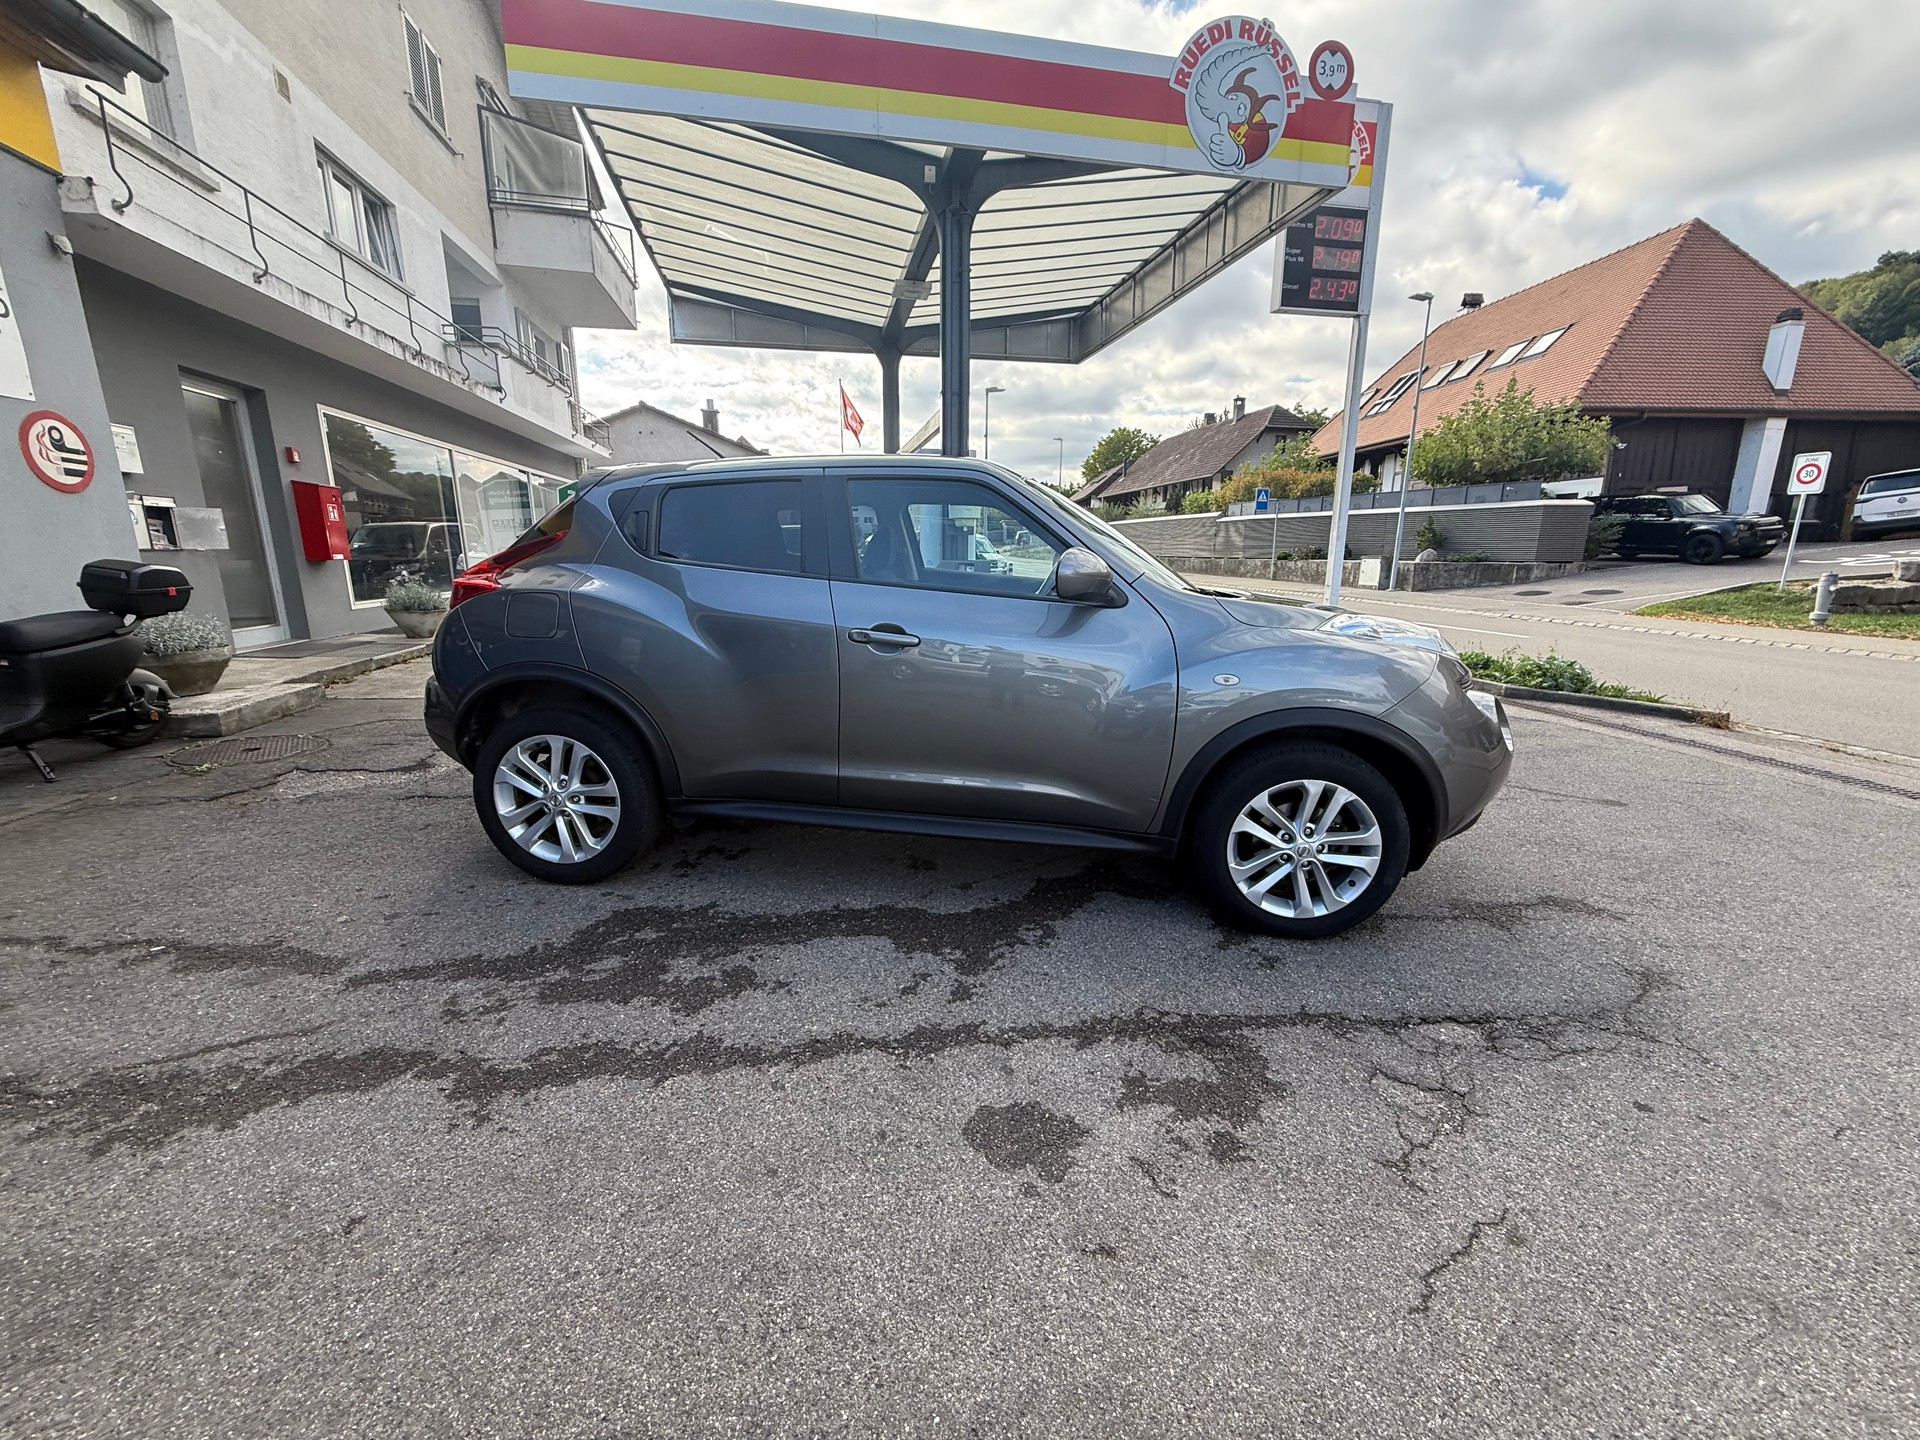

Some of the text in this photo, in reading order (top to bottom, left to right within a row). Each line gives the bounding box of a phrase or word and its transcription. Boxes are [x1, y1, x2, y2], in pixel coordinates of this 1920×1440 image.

[1174, 19, 1301, 108] RUEDI RÜSSEL
[1319, 60, 1346, 77] 3,9 m
[1285, 247, 1302, 255] Super
[1803, 469, 1815, 479] 30
